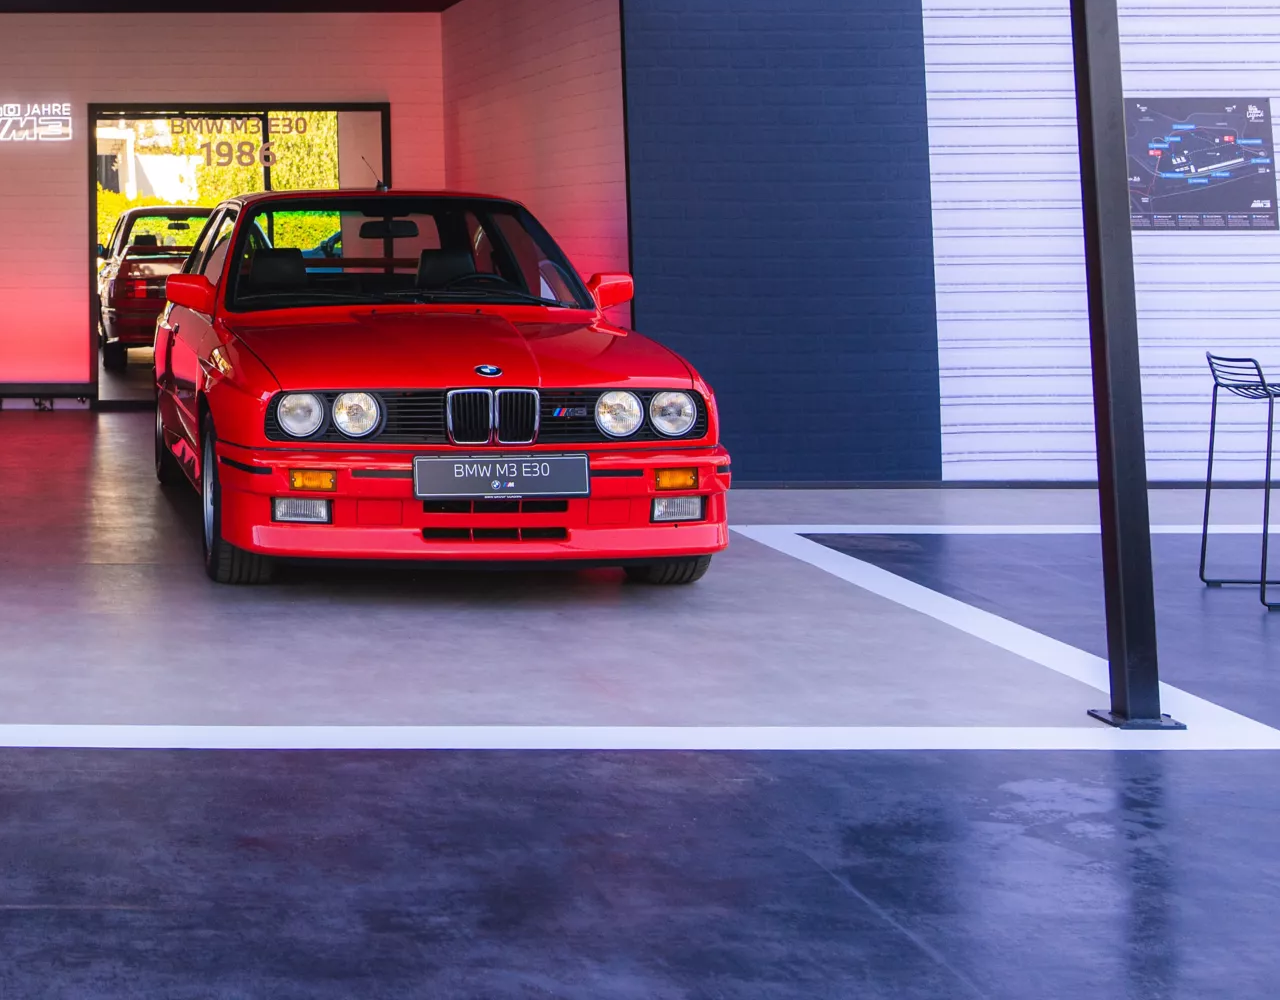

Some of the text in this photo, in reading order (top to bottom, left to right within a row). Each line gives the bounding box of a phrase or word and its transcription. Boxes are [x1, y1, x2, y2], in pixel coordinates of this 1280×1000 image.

[24, 103, 71, 116] JAHRE
[0, 116, 72, 141] M3
[170, 117, 308, 134] BMW M3 E30
[200, 141, 277, 167] 1986
[454, 462, 550, 478] BMW M3 E30
